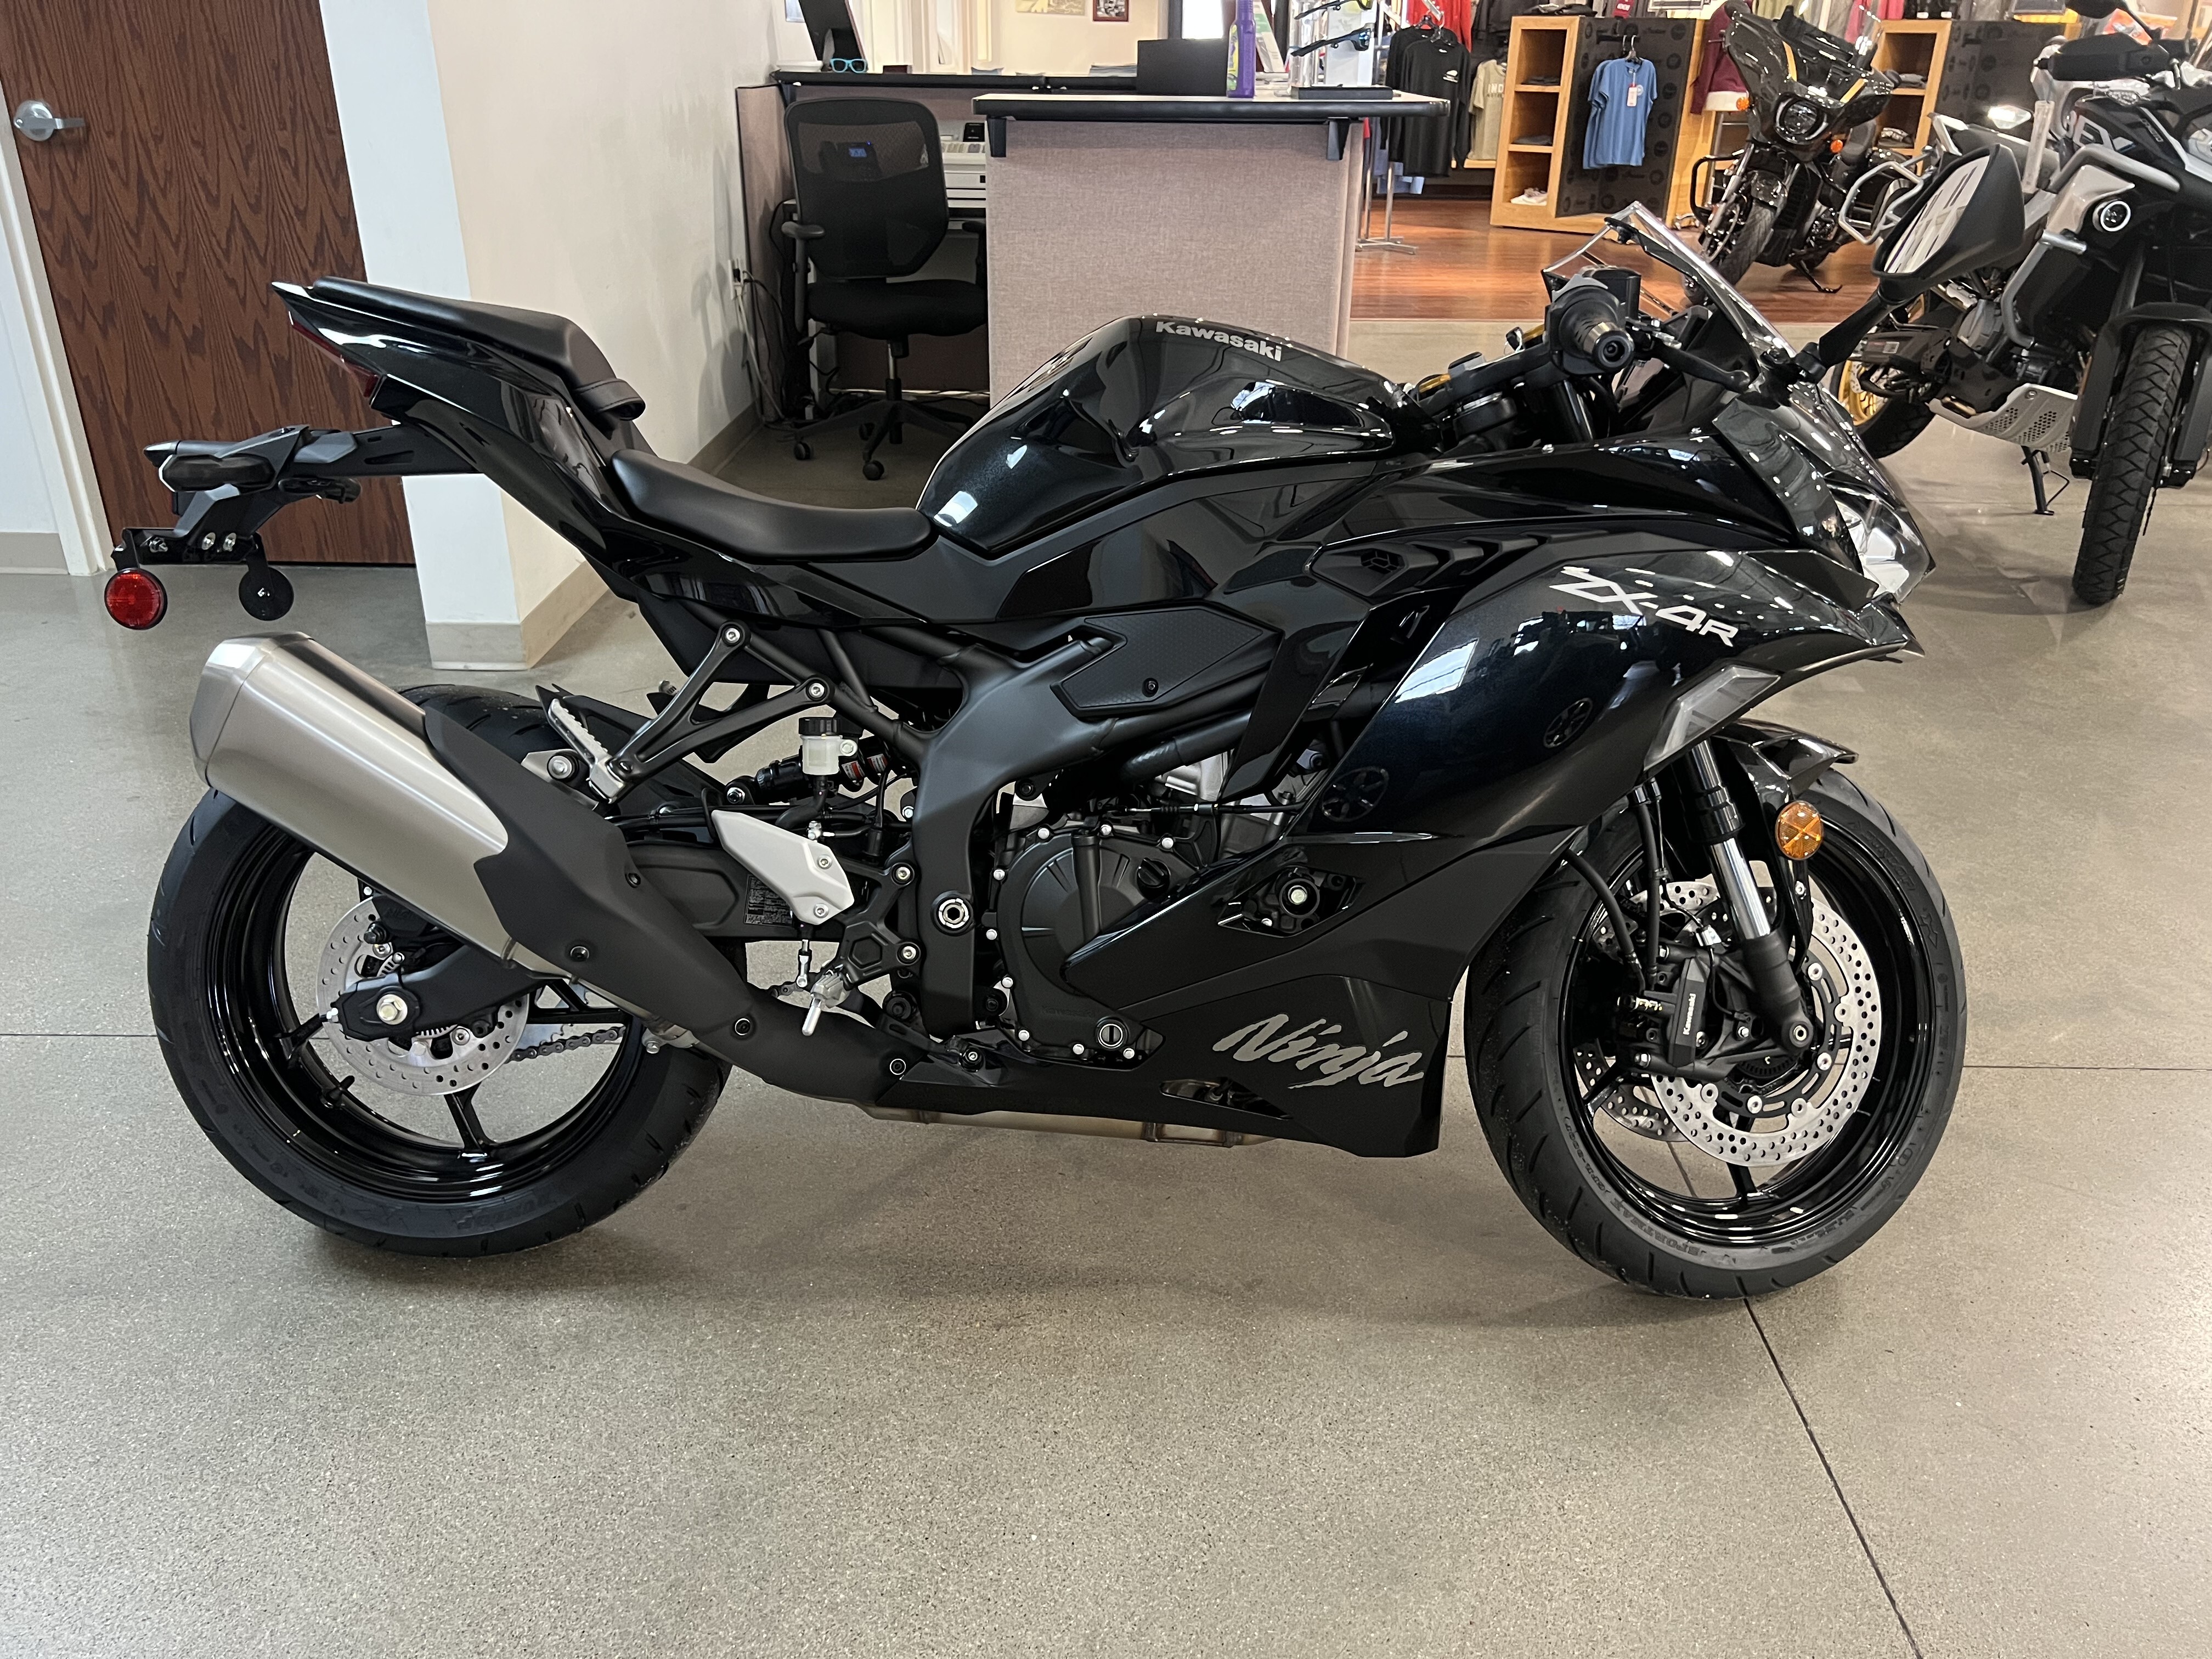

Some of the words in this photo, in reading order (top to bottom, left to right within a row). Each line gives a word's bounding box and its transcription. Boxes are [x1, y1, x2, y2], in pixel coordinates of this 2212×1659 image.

[1156, 321, 1282, 361] Kawasaki
[1550, 567, 1738, 646] ZX-4R
[1683, 993, 1696, 1035] Kawasaki
[1213, 1014, 1424, 1089] Ninja
[1610, 1198, 1700, 1256] SPORTMAX
